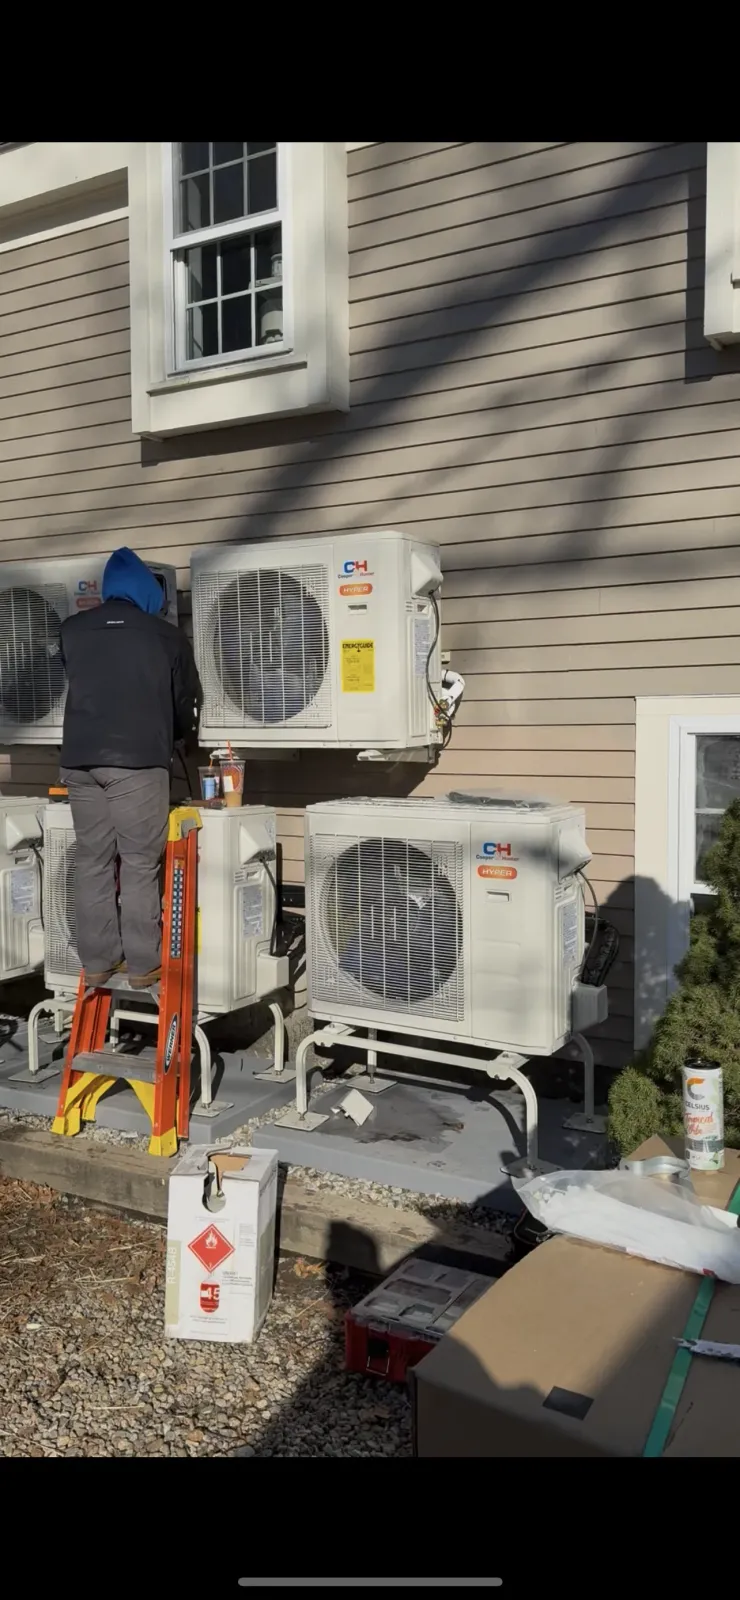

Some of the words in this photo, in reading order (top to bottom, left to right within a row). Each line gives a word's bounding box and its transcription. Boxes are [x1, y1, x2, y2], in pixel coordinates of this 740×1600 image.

[343, 560, 368, 574] CH
[78, 580, 98, 592] CH
[483, 842, 512, 856] CH
[482, 869, 513, 877] HYPER
[166, 1024, 177, 1062] WERNER
[685, 1100, 711, 1111] CELSIUS
